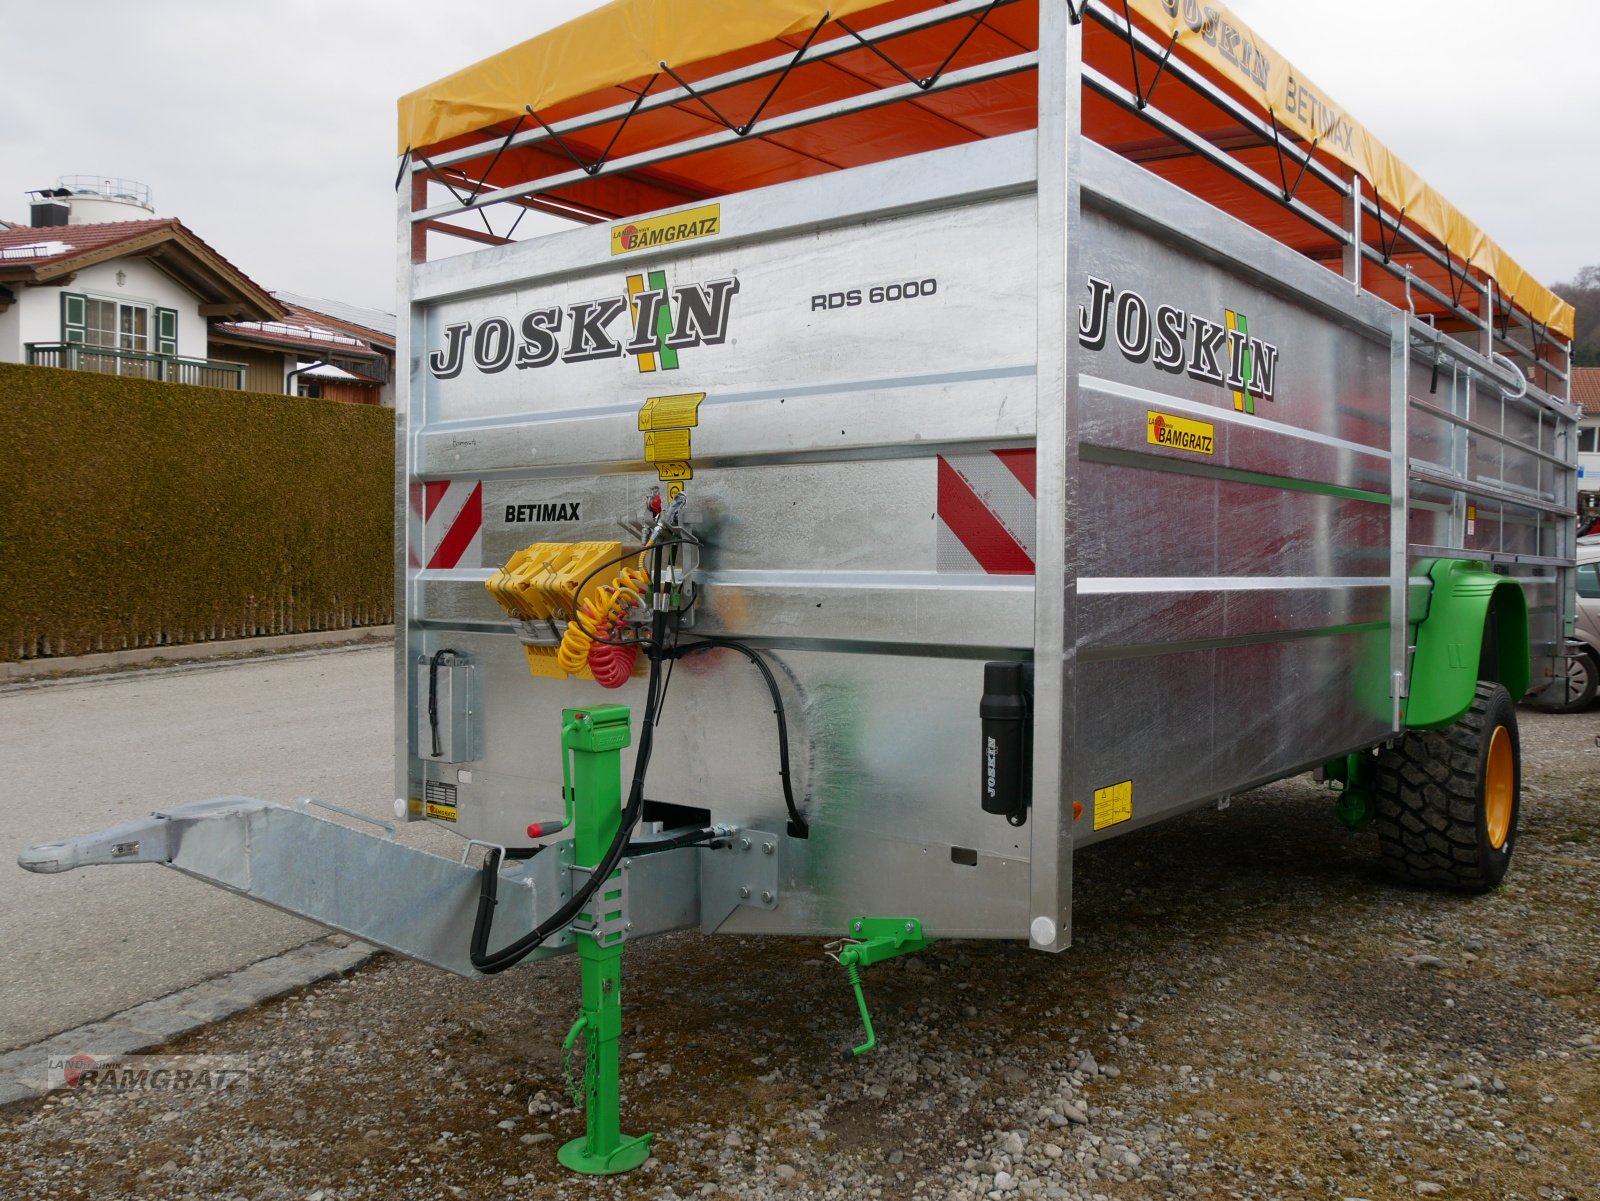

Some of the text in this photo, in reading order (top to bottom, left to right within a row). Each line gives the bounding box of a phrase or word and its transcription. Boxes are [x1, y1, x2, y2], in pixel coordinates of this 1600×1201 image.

[1285, 76, 1355, 158] BETIMAX
[627, 217, 718, 249] BAMGRATZ
[811, 278, 937, 311] RDS 6000
[429, 277, 740, 379] JOSKIN
[1079, 275, 1279, 402] JOSKIN
[1158, 428, 1212, 451] BAMGRATZ
[505, 502, 580, 522] BETIMAX
[987, 736, 996, 797] JOSKIN
